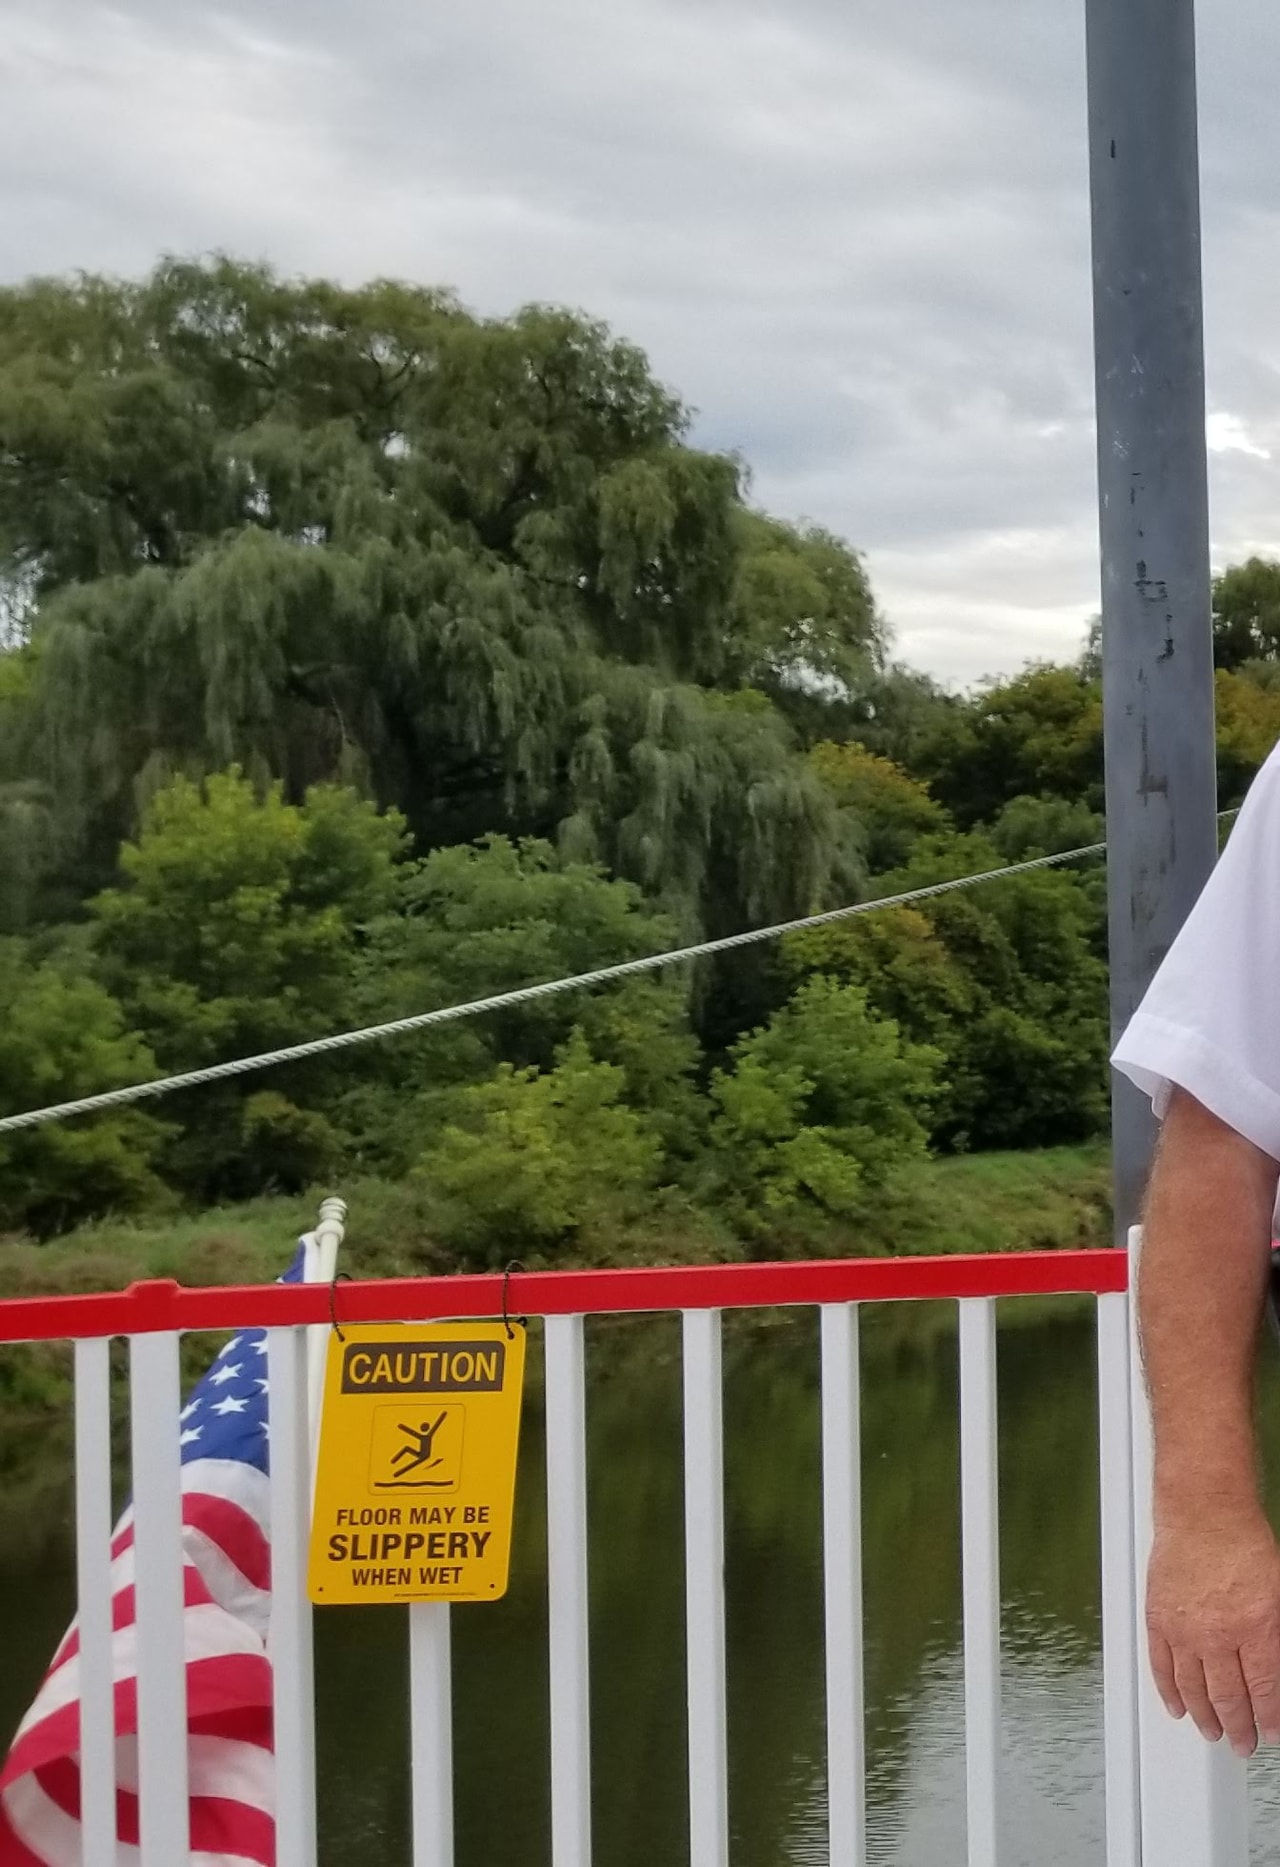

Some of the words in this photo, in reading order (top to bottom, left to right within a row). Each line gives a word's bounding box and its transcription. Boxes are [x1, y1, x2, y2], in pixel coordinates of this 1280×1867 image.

[350, 1352, 497, 1384] CAUTION
[336, 1508, 401, 1526] FLOOR
[409, 1507, 456, 1524] MAY
[463, 1506, 490, 1523] BE
[328, 1532, 491, 1561] SLIPPERY
[352, 1568, 411, 1586] WHEN
[419, 1567, 463, 1585] WET
